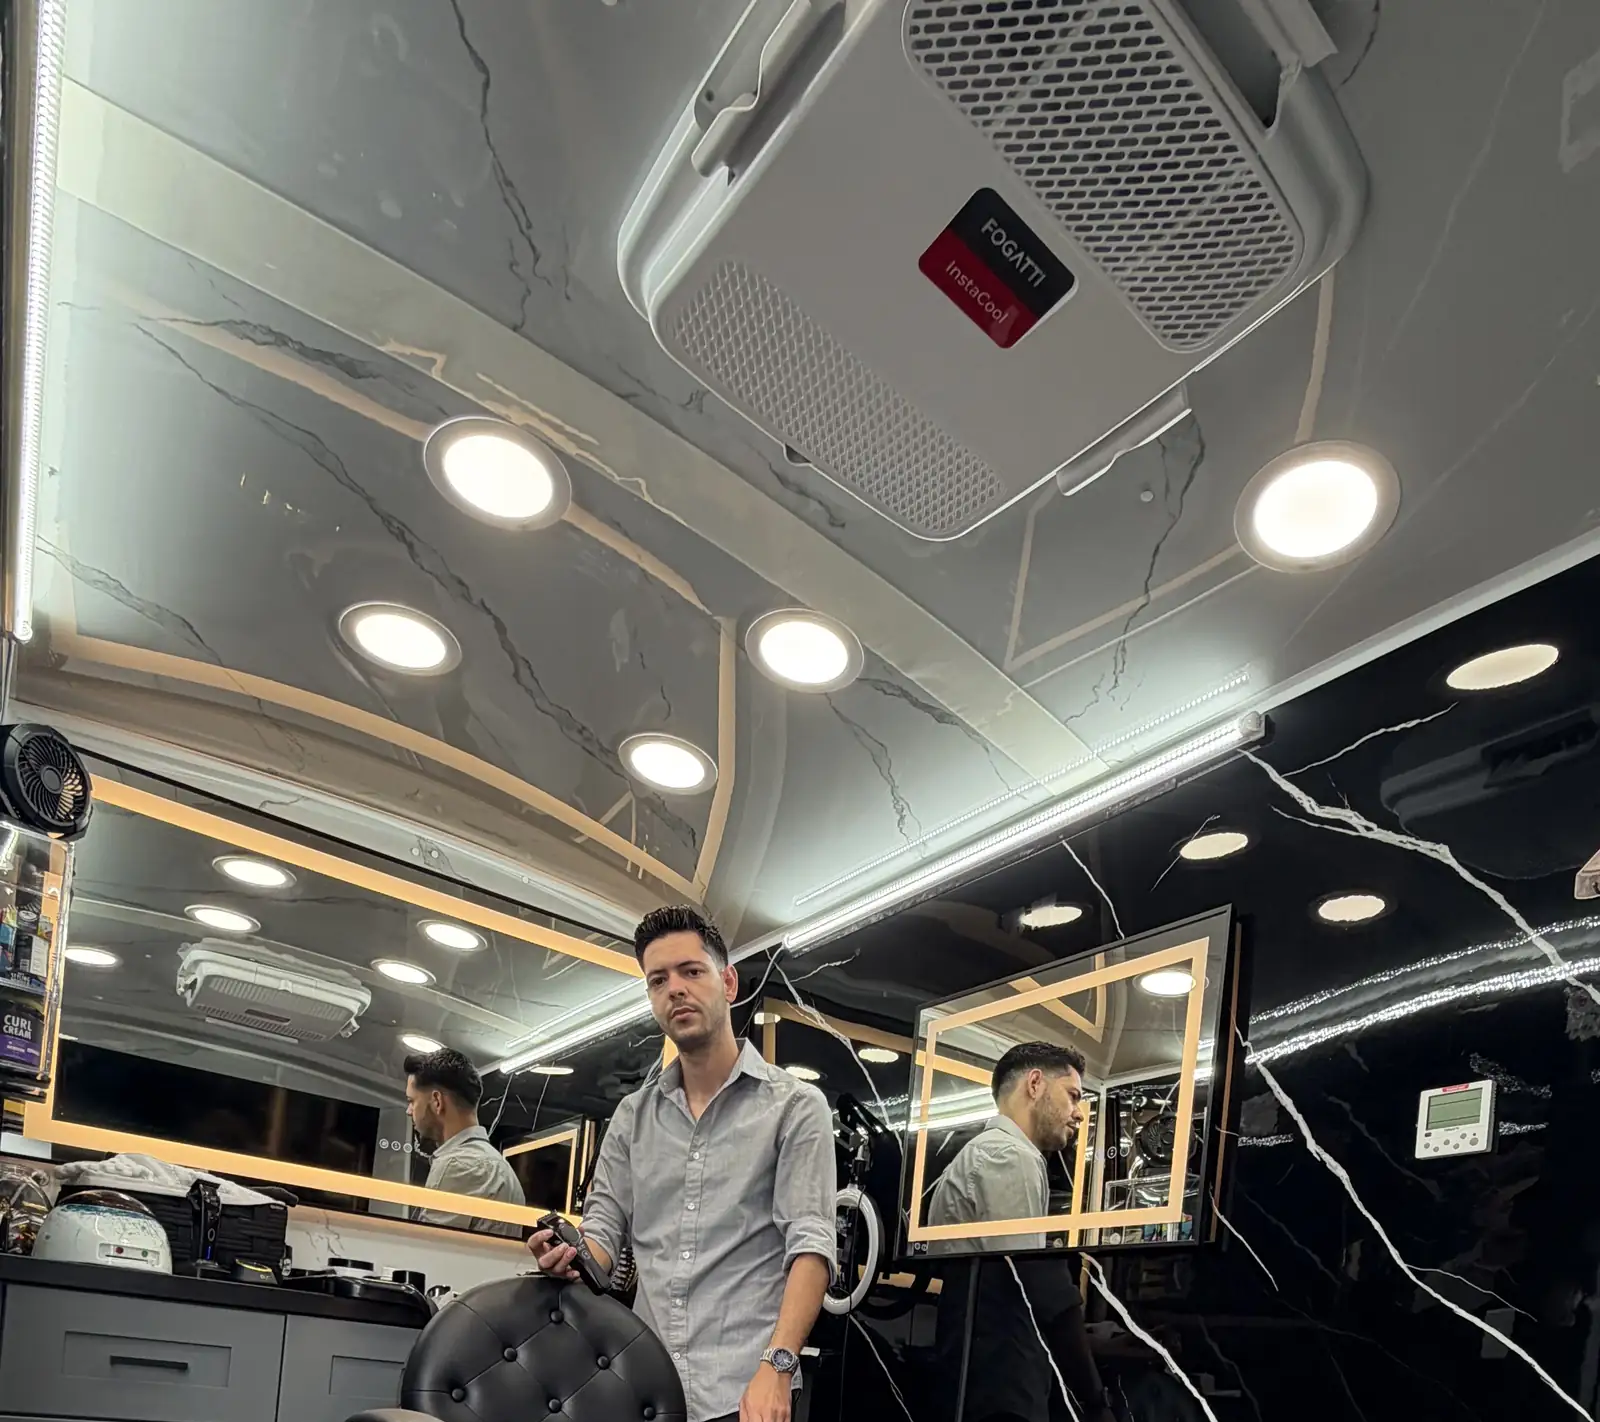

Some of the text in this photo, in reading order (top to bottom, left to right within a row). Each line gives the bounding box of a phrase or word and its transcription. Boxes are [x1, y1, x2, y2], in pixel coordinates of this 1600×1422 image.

[981, 218, 1046, 288] FOGATTI
[946, 261, 1008, 324] InstaCool
[3, 1025, 32, 1040] CREAM
[4, 1014, 33, 1032] CURL
